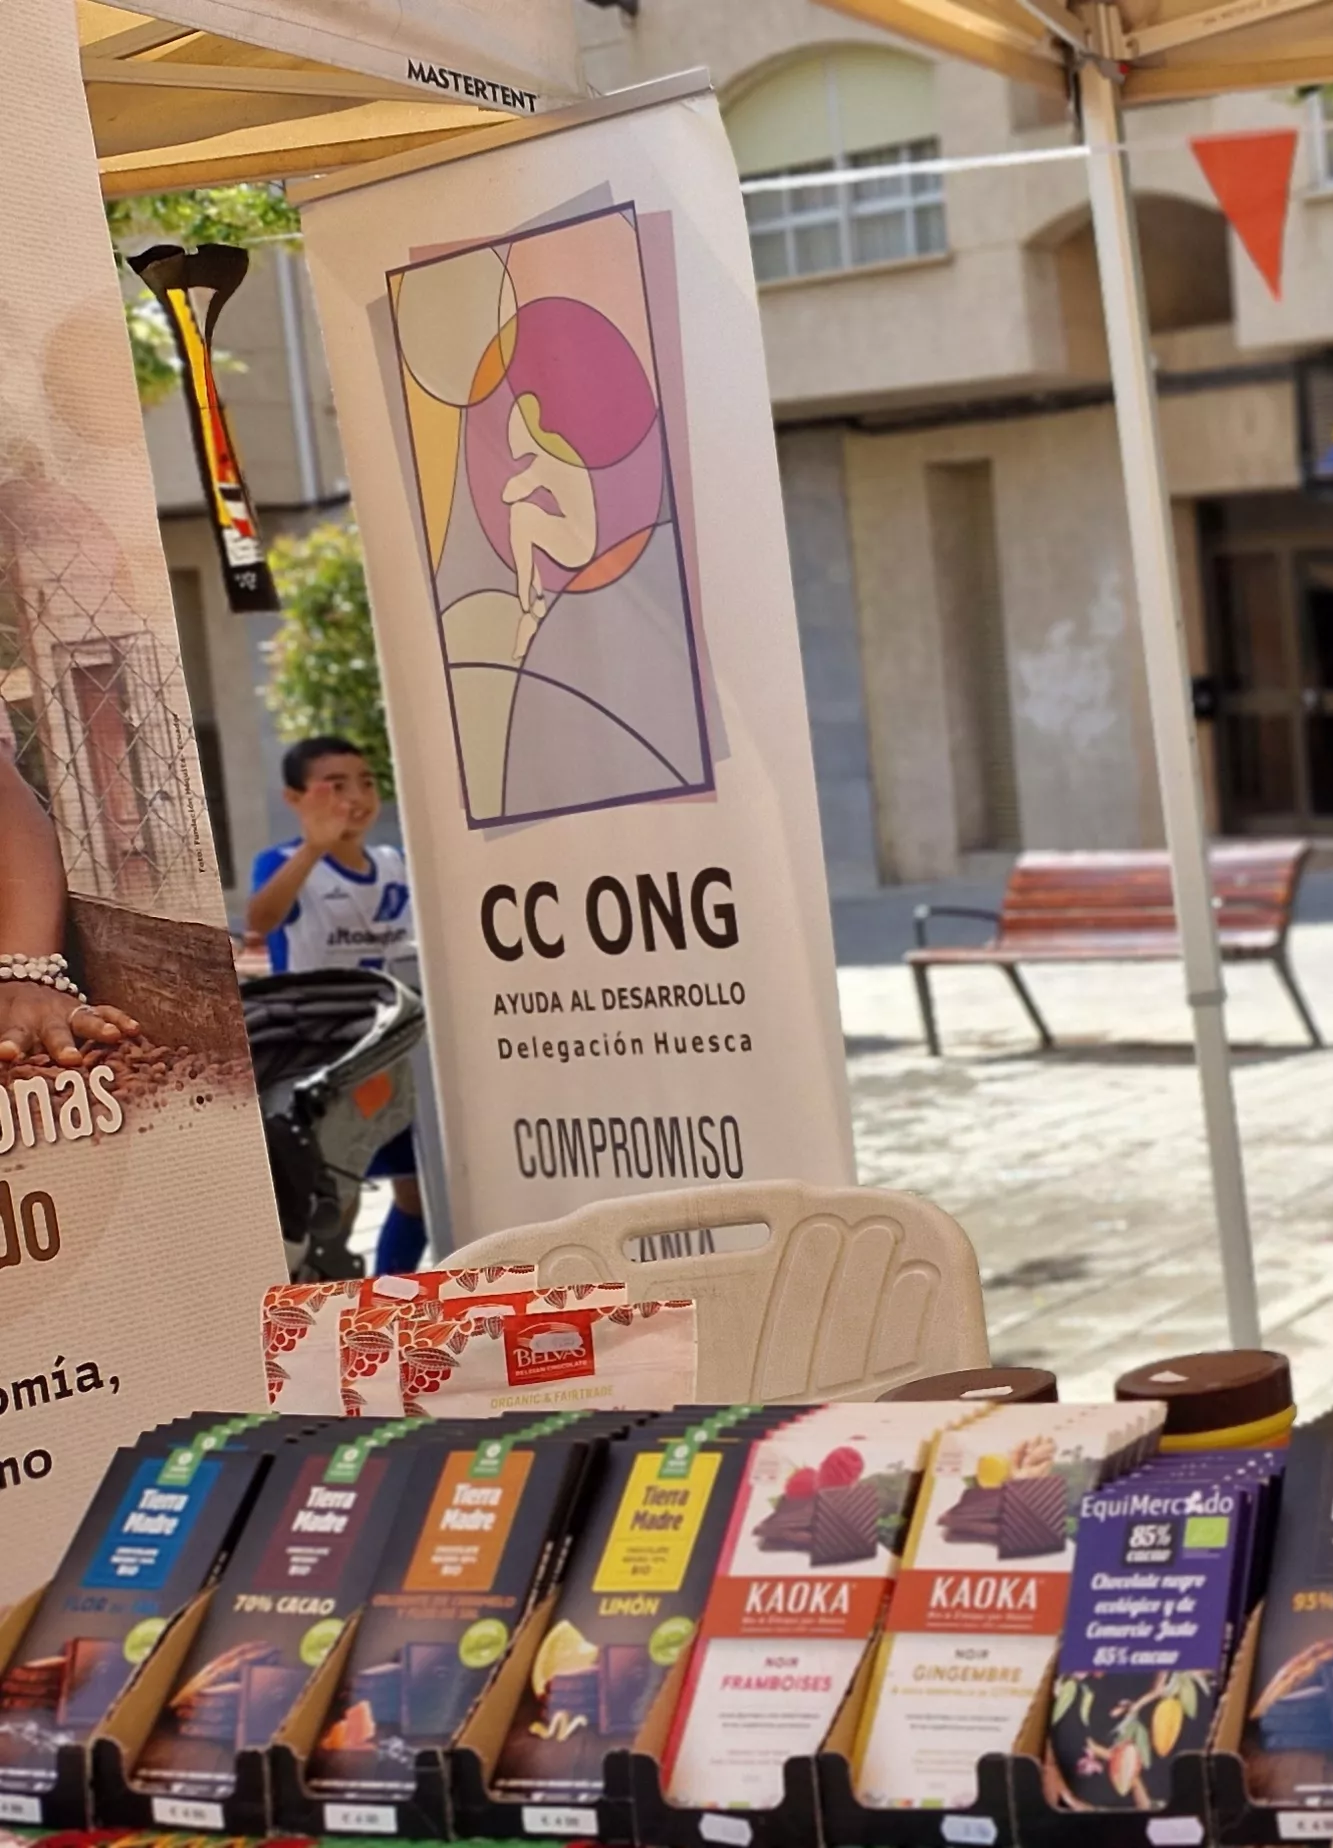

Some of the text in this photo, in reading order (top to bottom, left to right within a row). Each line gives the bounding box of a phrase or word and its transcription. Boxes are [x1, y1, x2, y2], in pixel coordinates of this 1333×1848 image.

[407, 58, 537, 112] MASTERTENT
[173, 713, 184, 750] Ecuador
[187, 799, 201, 845] Fundación
[197, 848, 206, 874] Foto:
[480, 867, 740, 962] CC ONG
[493, 981, 746, 1016] AYUDA AL DESARROLLO
[497, 1030, 753, 1063] Delegación Huesca
[513, 1115, 744, 1179] COMPROMISO
[490, 1393, 541, 1410] ORGANIC
[554, 1385, 615, 1402] FAIRTRADE
[138, 1488, 190, 1514] Tierra
[305, 1487, 357, 1512] Tierra
[452, 1483, 503, 1507] Tierra
[641, 1486, 690, 1509] Tierra
[122, 1511, 180, 1537] Madre
[291, 1509, 349, 1535] Madre
[440, 1507, 497, 1532] Madre
[629, 1510, 685, 1532] Madre
[1128, 1523, 1172, 1549] 85%
[1125, 1548, 1172, 1564] cacao
[629, 1564, 652, 1576] BIO
[929, 1576, 1039, 1611] KAOKA
[1091, 1572, 1206, 1594] Chocolate negro
[234, 1594, 335, 1616] 70% CACAO
[599, 1594, 661, 1616] LIMÓN
[744, 1580, 851, 1615] KAOKA
[1094, 1595, 1160, 1618] ecológico
[1175, 1595, 1197, 1615] de
[1086, 1621, 1198, 1642] Comercio Justo
[764, 1656, 799, 1669] NOIR
[954, 1648, 989, 1660] NOIR
[1130, 1649, 1180, 1666] cacao
[720, 1675, 833, 1693] FRAMBOISES
[912, 1665, 1022, 1683] GINGEMBRE
